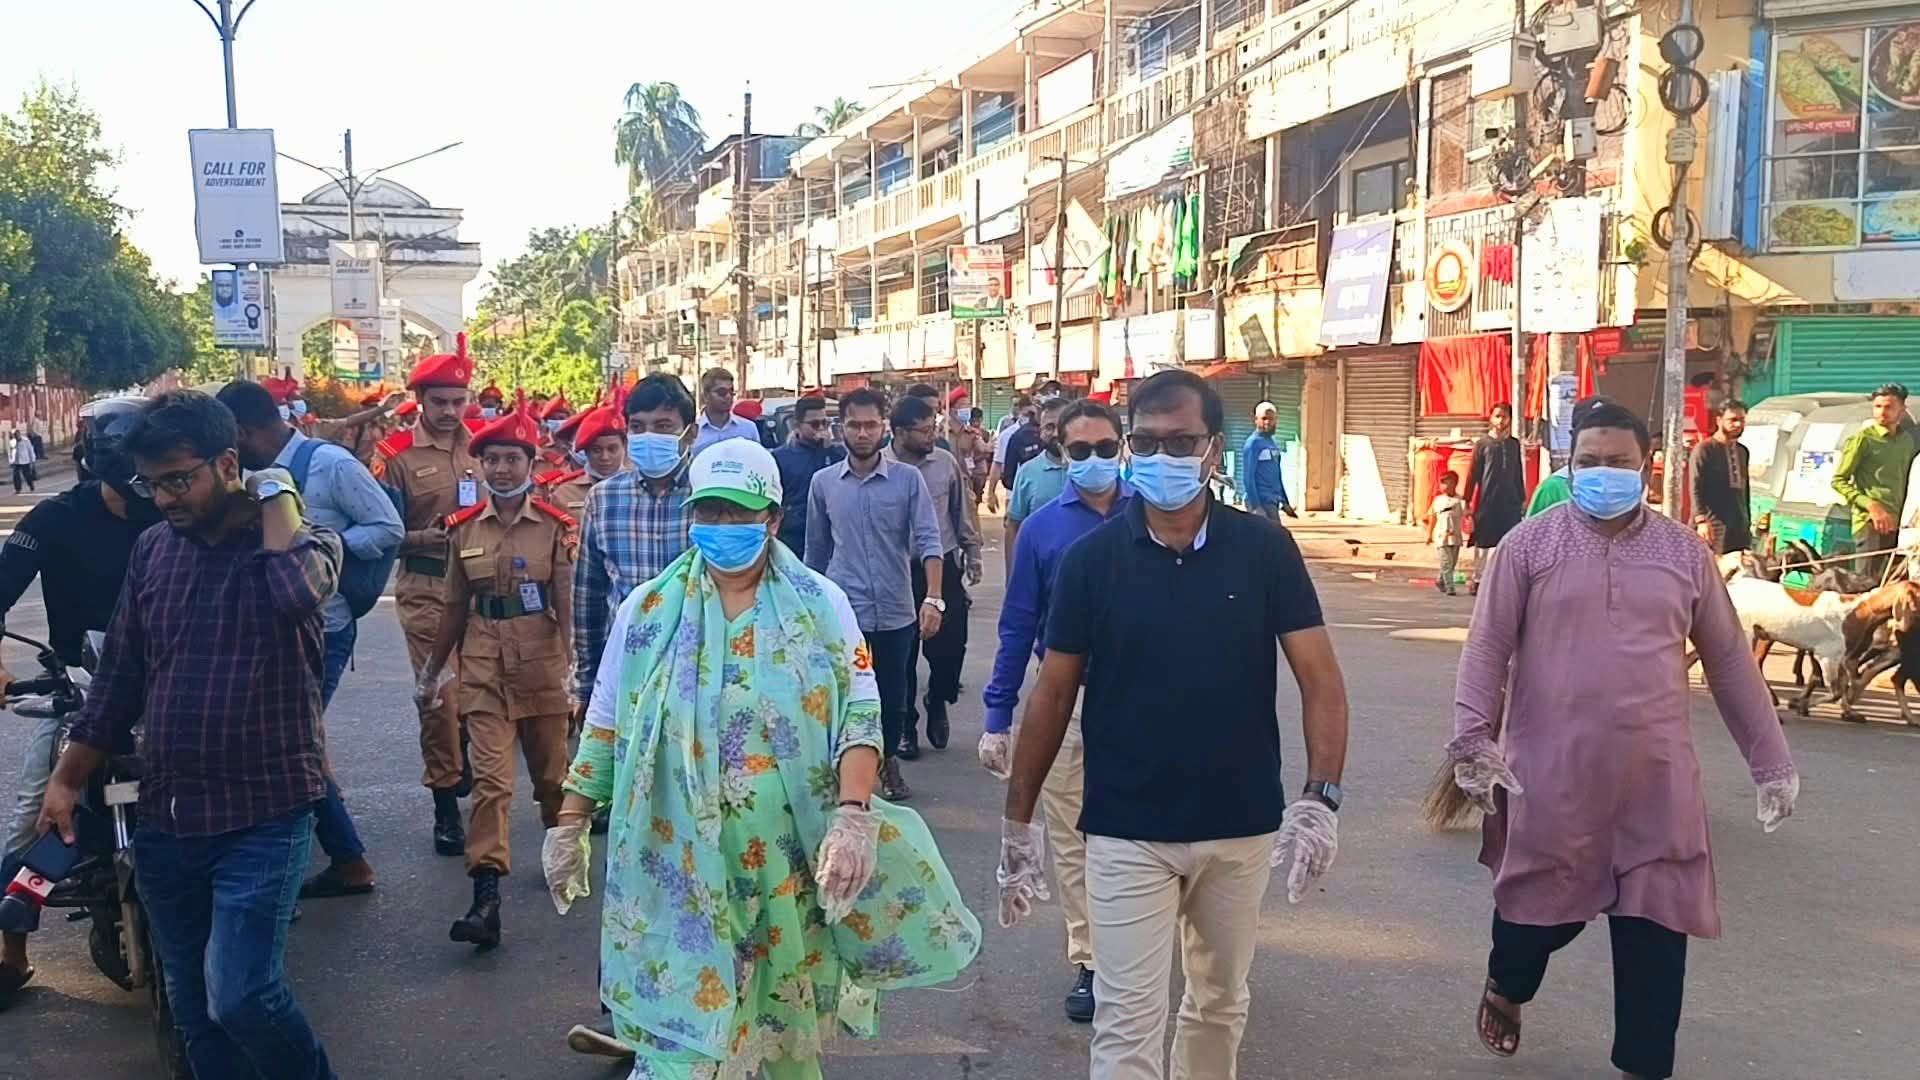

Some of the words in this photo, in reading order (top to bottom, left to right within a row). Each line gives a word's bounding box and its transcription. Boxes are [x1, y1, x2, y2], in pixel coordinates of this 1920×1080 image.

[203, 161, 234, 175] CALL
[239, 161, 266, 175] FOR
[204, 177, 266, 187] ADVERTISEMENT
